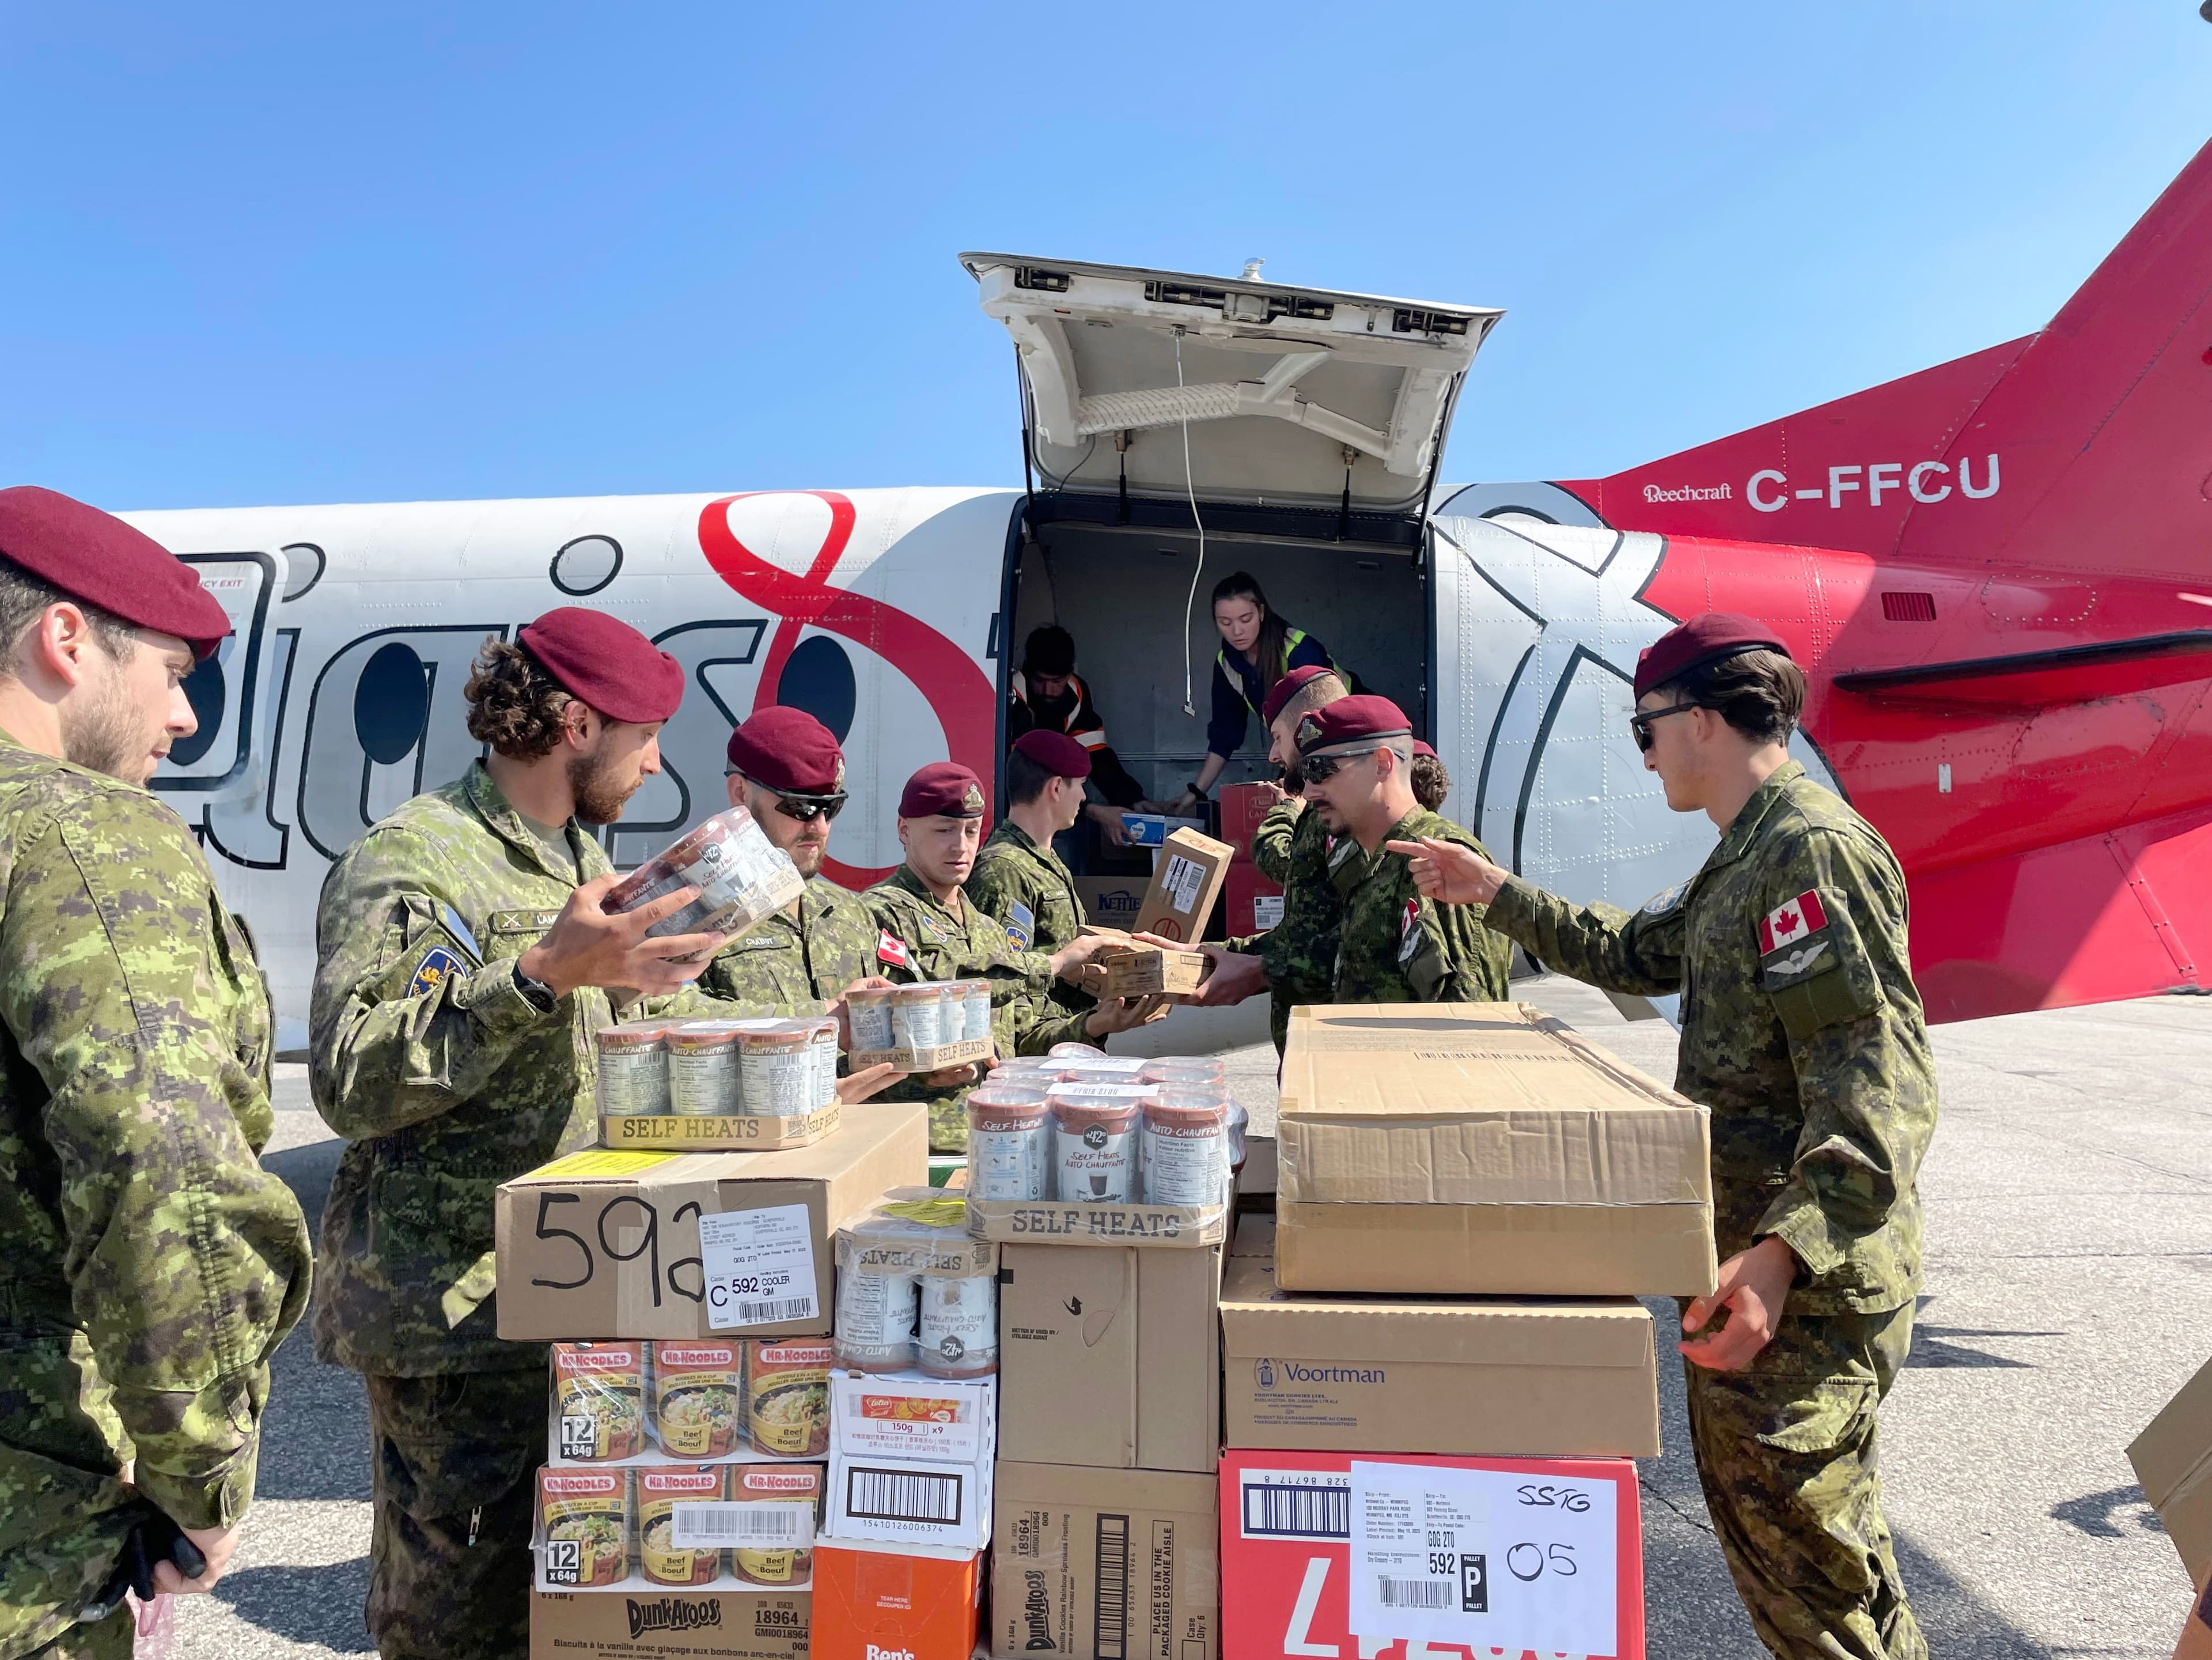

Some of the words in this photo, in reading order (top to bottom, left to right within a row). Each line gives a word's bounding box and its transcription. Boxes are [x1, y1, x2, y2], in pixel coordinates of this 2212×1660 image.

[1746, 453, 2000, 512] C-FFCU
[1643, 483, 1732, 503] Beechcraft
[880, 1054, 910, 1063] HEATS
[938, 1046, 956, 1062] SELF
[959, 1041, 986, 1056] HEATS
[623, 1119, 677, 1138] SELF
[685, 1119, 759, 1138] HEATS
[809, 1116, 823, 1133] SELF
[1065, 1158, 1126, 1168] AUTO-CHAUFFANTE
[1071, 1152, 1095, 1160] SELF
[1098, 1151, 1119, 1160] HEATS
[1013, 1210, 1079, 1234] SELF
[1088, 1211, 1179, 1238] HEATS
[732, 1277, 759, 1294] 592
[762, 1276, 790, 1286] COOLER
[710, 1285, 728, 1307] C
[763, 1288, 774, 1296] GM
[955, 1324, 979, 1332] SELF
[1285, 1363, 1385, 1383] Voortman
[564, 1418, 591, 1442] 12
[683, 1430, 702, 1438] Beef
[783, 1428, 802, 1436] Beef
[892, 1423, 913, 1433] 150g
[678, 1439, 702, 1447] Boeuf
[777, 1438, 801, 1446] Boeuf
[572, 1445, 592, 1457] 64g
[1280, 1476, 1317, 1485] 86717
[1062, 1514, 1070, 1541] Frosting
[1019, 1519, 1029, 1556] 18964
[554, 1543, 576, 1567] 12
[1154, 1548, 1162, 1567] THE
[661, 1566, 685, 1574] Boeuf
[1430, 1553, 1455, 1574] 592
[557, 1571, 577, 1583] 64g
[1154, 1571, 1162, 1582] IN
[1465, 1567, 1481, 1598] P
[1154, 1585, 1161, 1598] US
[755, 1610, 798, 1625] 18964
[1128, 1617, 1134, 1627] 00
[1153, 1602, 1161, 1634] PLACE
[1162, 1602, 1170, 1656] PACKAGED
[1187, 1617, 1195, 1638] Case
[554, 1639, 587, 1648] Biscuits
[597, 1641, 604, 1649] la
[607, 1642, 634, 1651] vanille
[658, 1644, 691, 1655] glaçage
[711, 1647, 748, 1657] bonbons
[750, 1651, 795, 1660] arc-en-ciel
[792, 1642, 808, 1651] 000
[866, 1644, 914, 1660] Ben's
